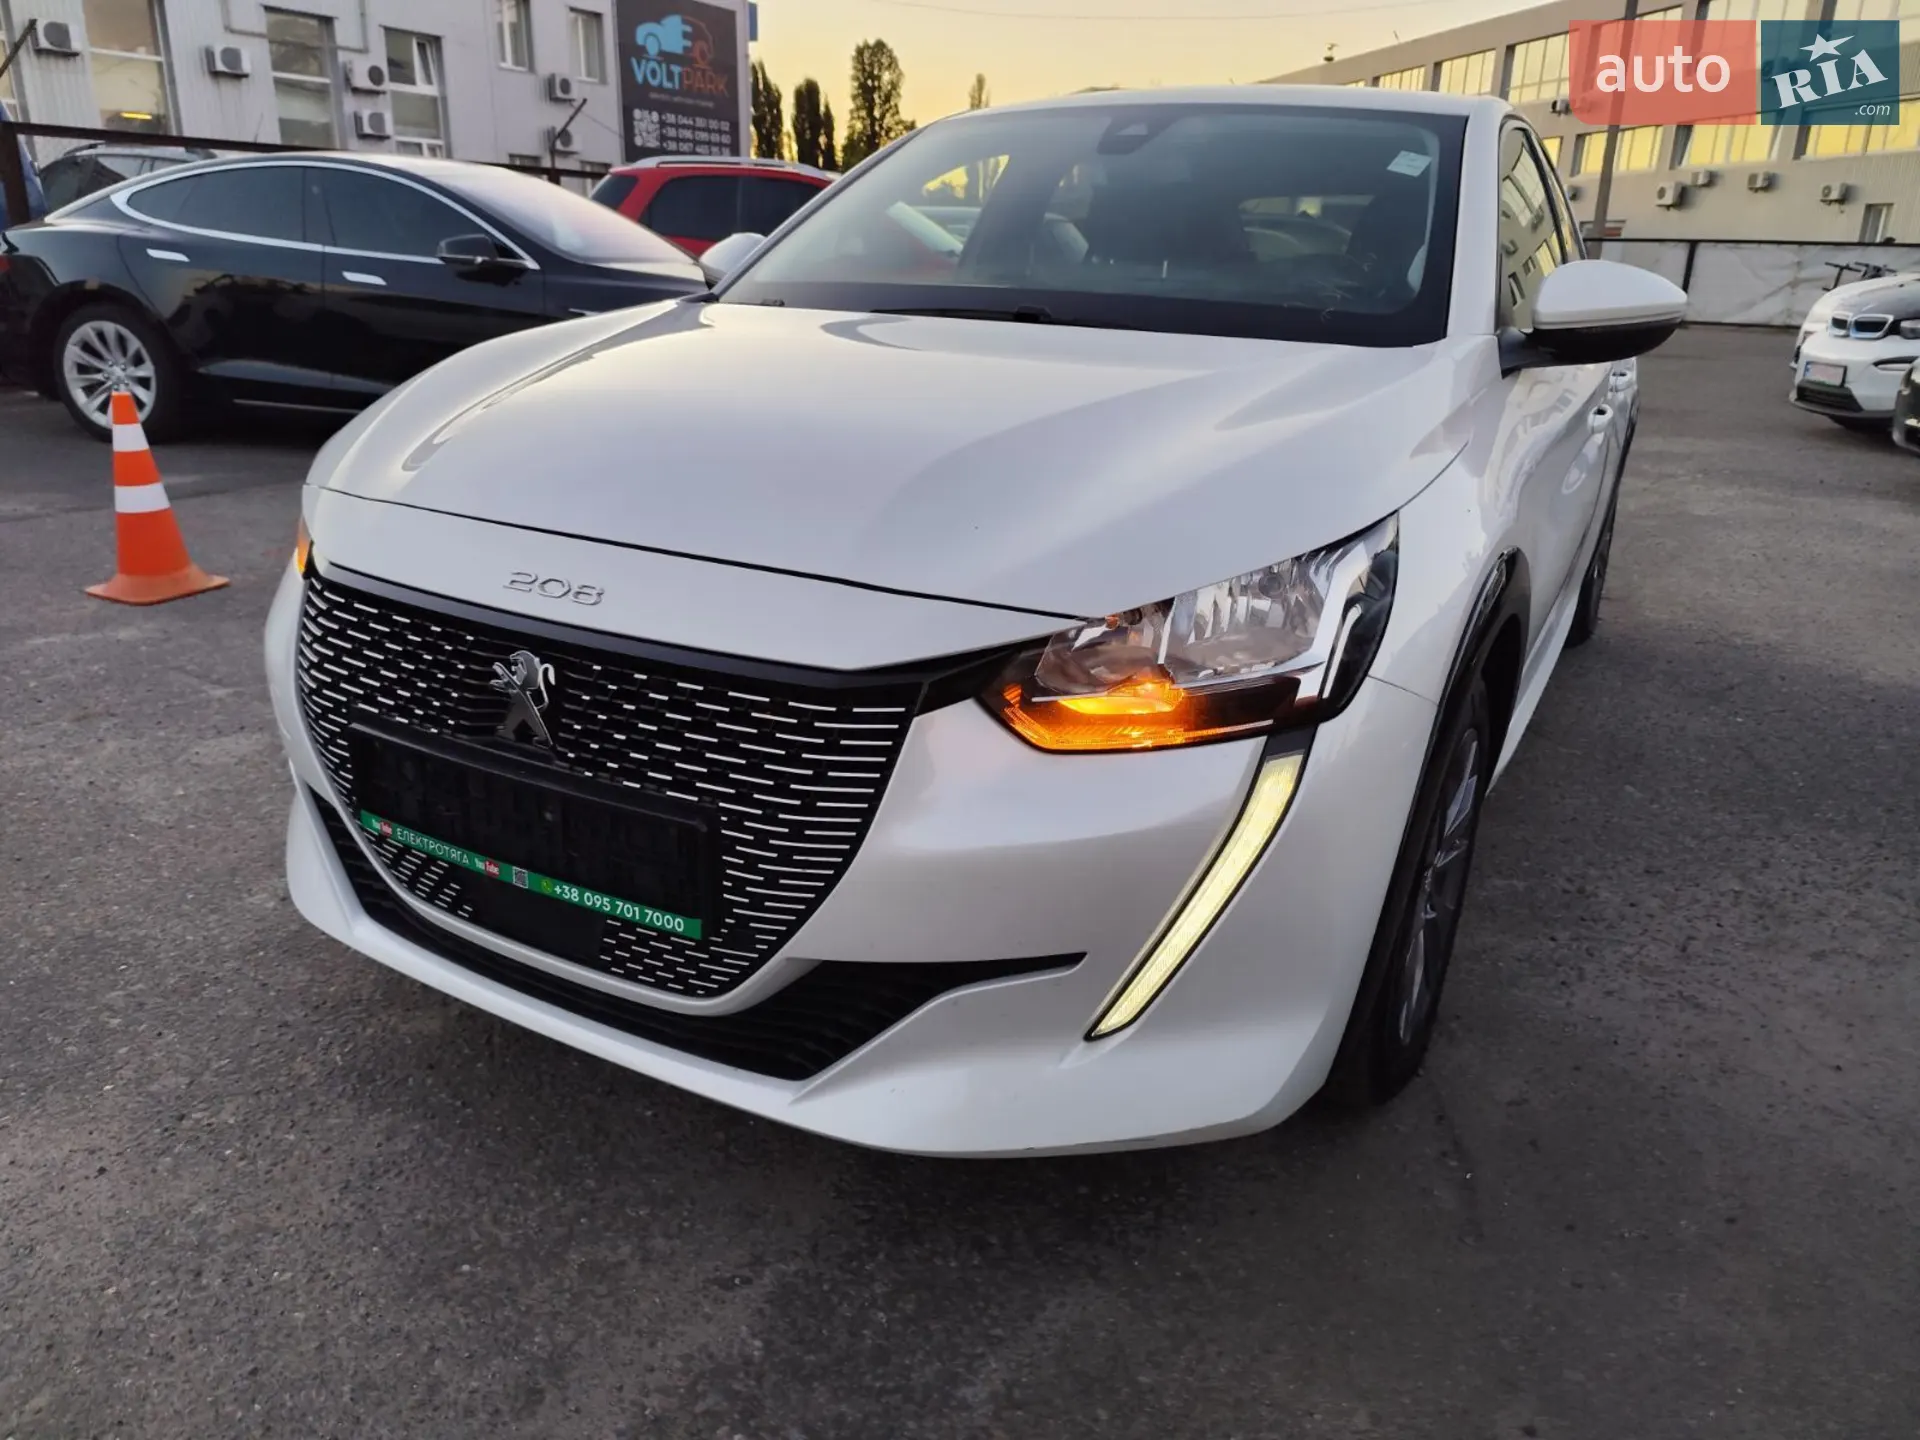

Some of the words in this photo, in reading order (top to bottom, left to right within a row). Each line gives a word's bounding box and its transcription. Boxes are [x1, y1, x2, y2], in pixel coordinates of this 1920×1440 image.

[502, 571, 605, 606] 208
[396, 828, 470, 865] ЕЛЕКТРОТЯГА
[554, 885, 580, 902] +38
[583, 892, 612, 912] 095
[615, 901, 640, 920] 701
[644, 909, 685, 932] 7000
